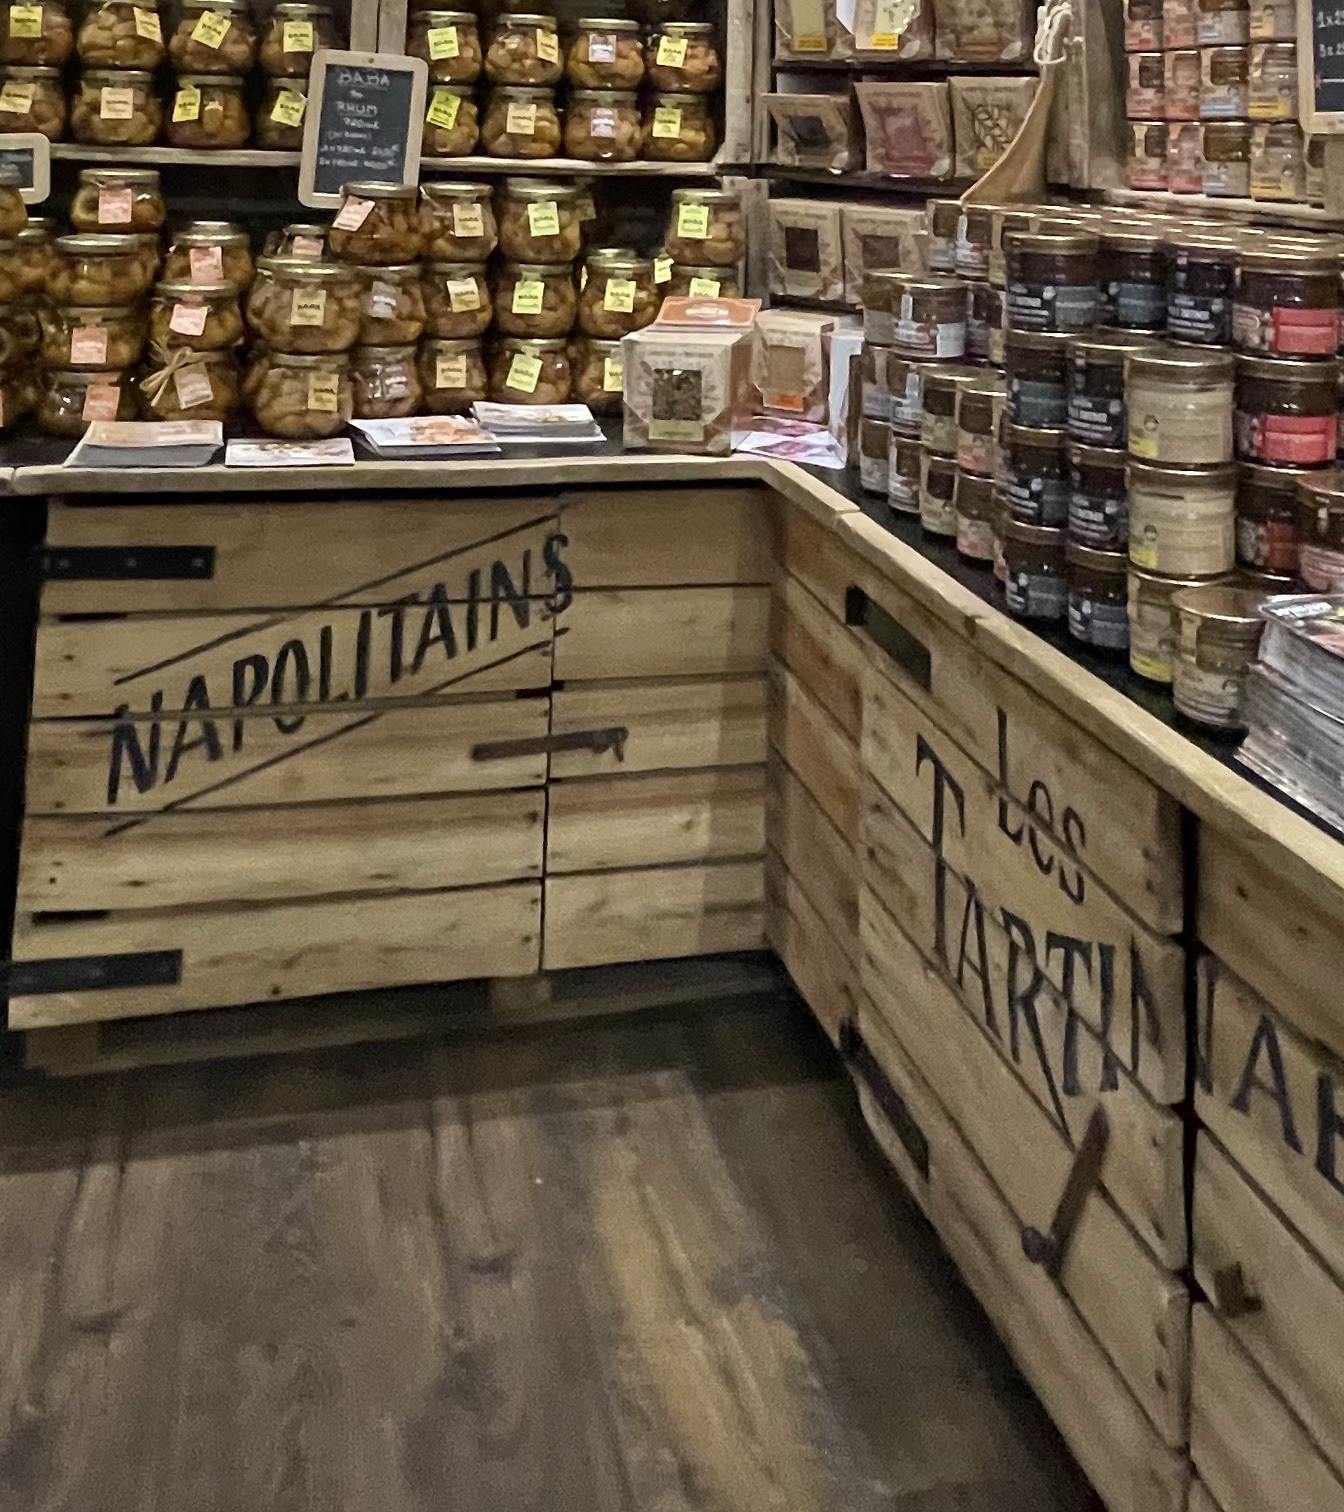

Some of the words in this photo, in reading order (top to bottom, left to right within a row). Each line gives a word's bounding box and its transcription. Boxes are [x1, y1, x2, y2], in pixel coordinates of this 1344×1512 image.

[335, 101, 377, 116] RHUM
[338, 70, 390, 87] BABA
[106, 533, 574, 805] NAPOLITAINS
[996, 707, 1087, 905] Les
